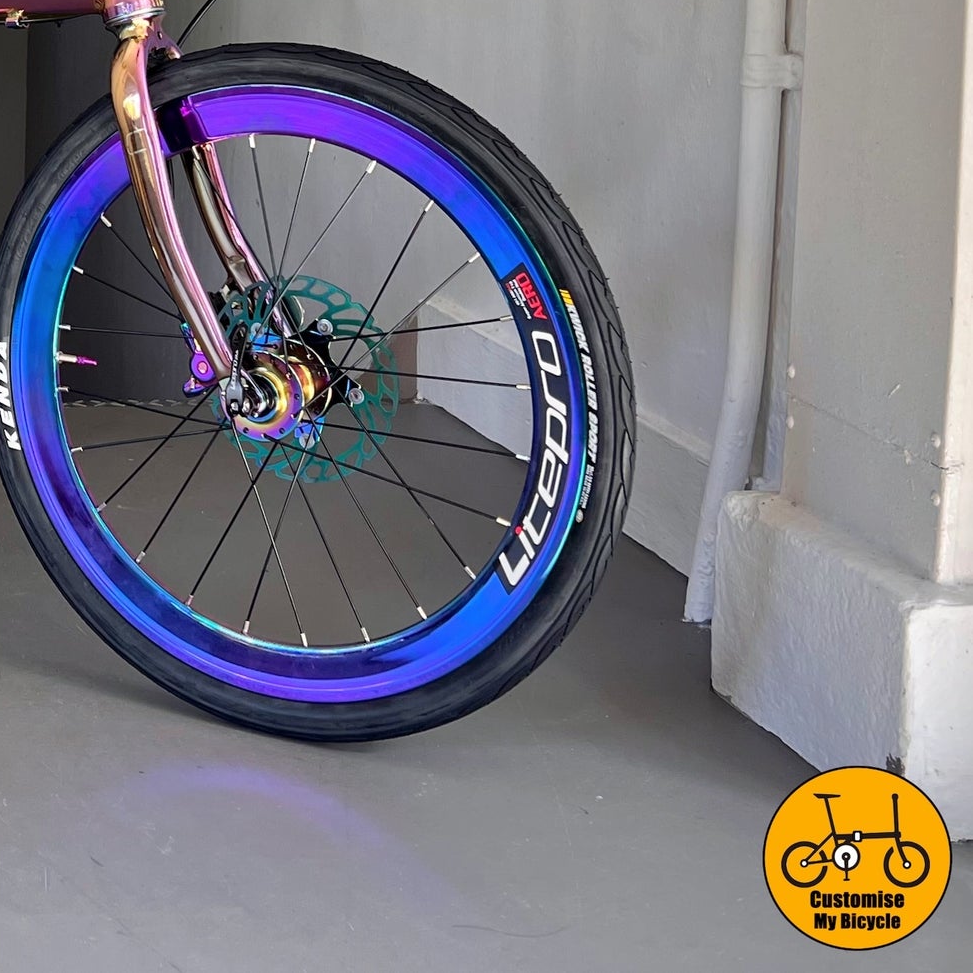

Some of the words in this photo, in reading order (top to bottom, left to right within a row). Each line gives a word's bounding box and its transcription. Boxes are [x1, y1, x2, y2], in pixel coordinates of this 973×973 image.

[516, 271, 547, 319] AERO
[569, 303, 589, 353] KWICK
[580, 353, 598, 410] ROLLER
[586, 411, 598, 463] SPORT
